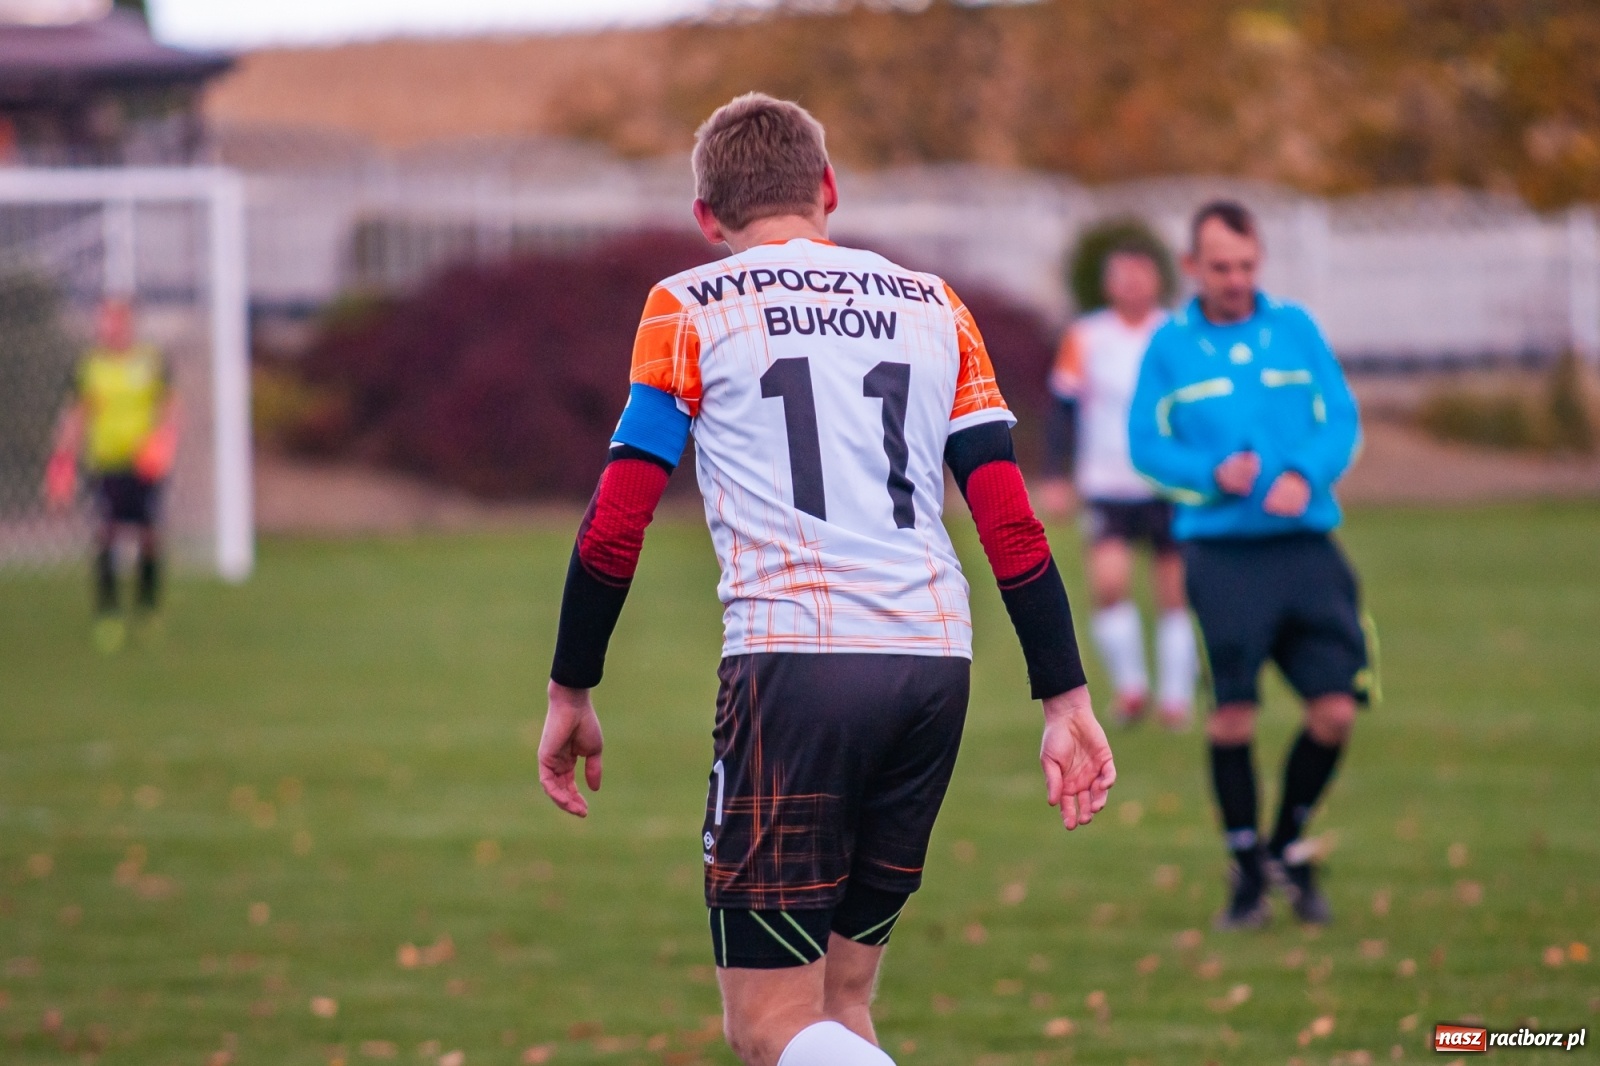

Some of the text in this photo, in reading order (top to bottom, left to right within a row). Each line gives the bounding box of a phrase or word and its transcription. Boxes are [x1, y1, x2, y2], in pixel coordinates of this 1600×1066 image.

[687, 269, 944, 306] WYPOCZYNEK
[764, 298, 897, 340] BUKÓW
[760, 356, 916, 530] 11
